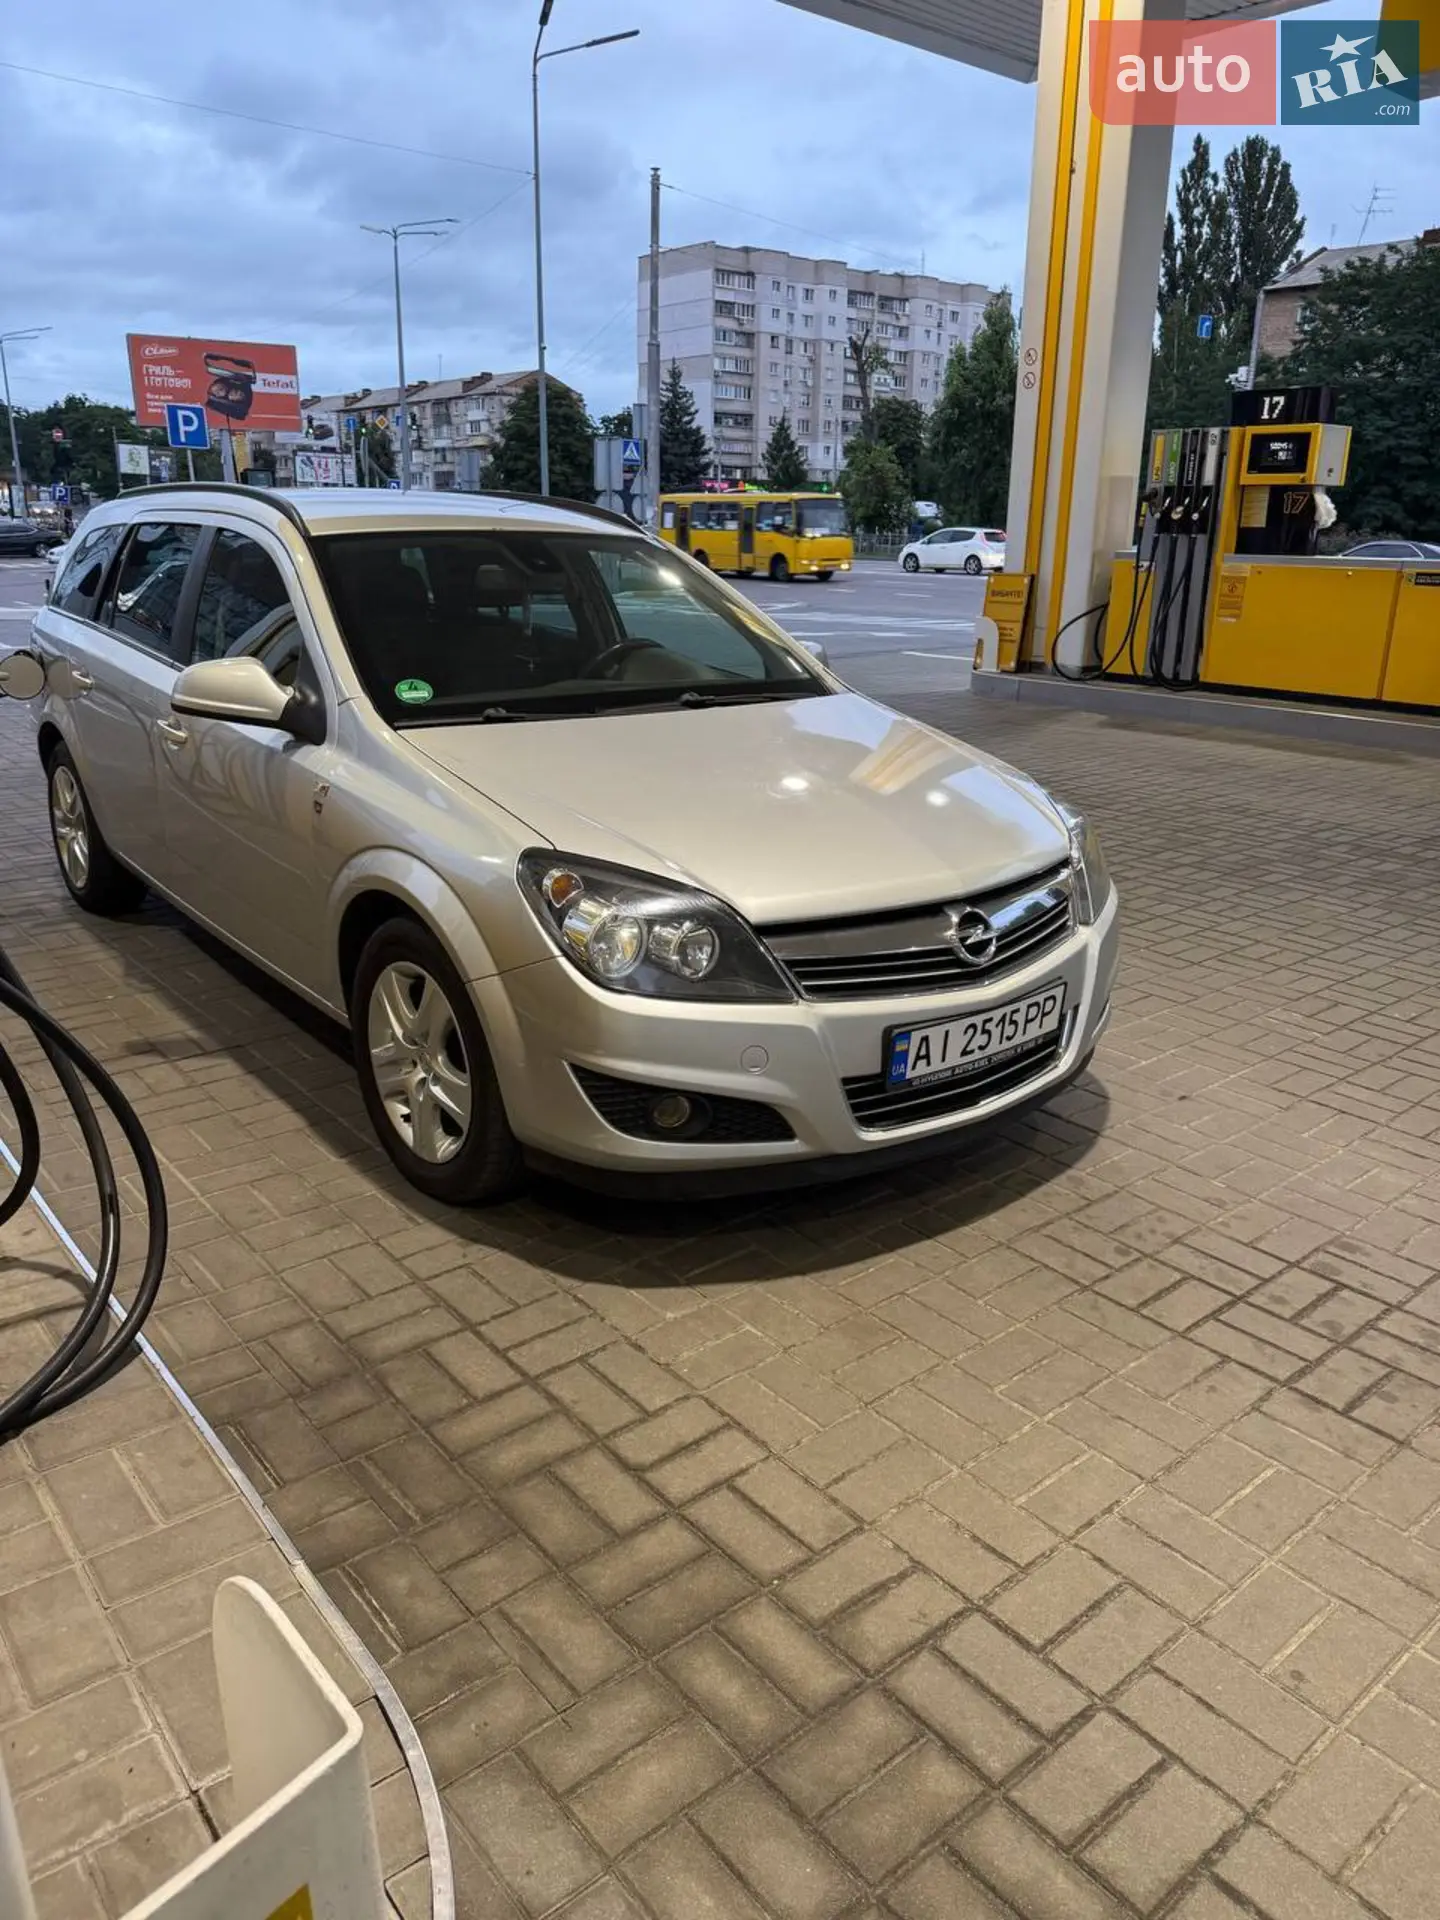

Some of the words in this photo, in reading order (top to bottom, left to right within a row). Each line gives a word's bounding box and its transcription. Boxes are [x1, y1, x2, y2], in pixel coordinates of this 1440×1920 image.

[261, 376, 295, 389] Tefal
[1260, 395, 1286, 420] 17
[176, 409, 199, 443] P
[55, 487, 66, 500] P
[1283, 491, 1309, 514] 17
[911, 1029, 949, 1071] AI
[891, 1062, 906, 1077] UA
